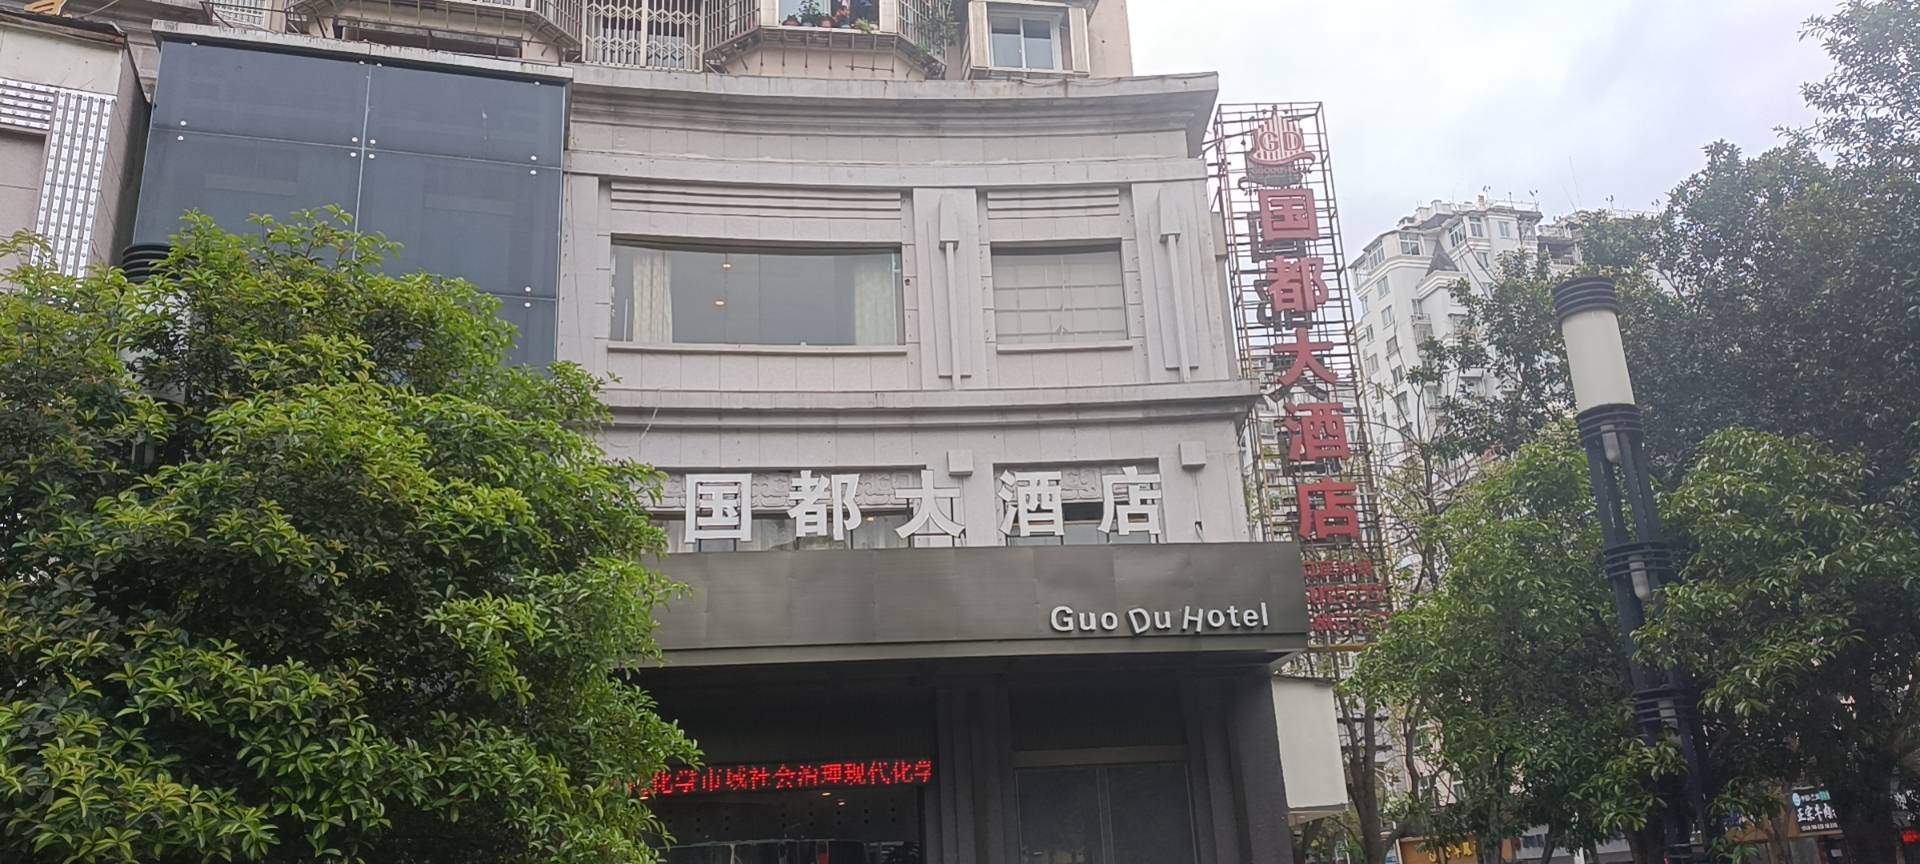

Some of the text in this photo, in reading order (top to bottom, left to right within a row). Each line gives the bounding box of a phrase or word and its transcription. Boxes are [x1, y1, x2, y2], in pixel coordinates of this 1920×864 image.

[1258, 188, 1361, 540] 国都大酒店
[684, 466, 1162, 544] 国都大酒店
[1050, 602, 1269, 635] Guo Du Hotel
